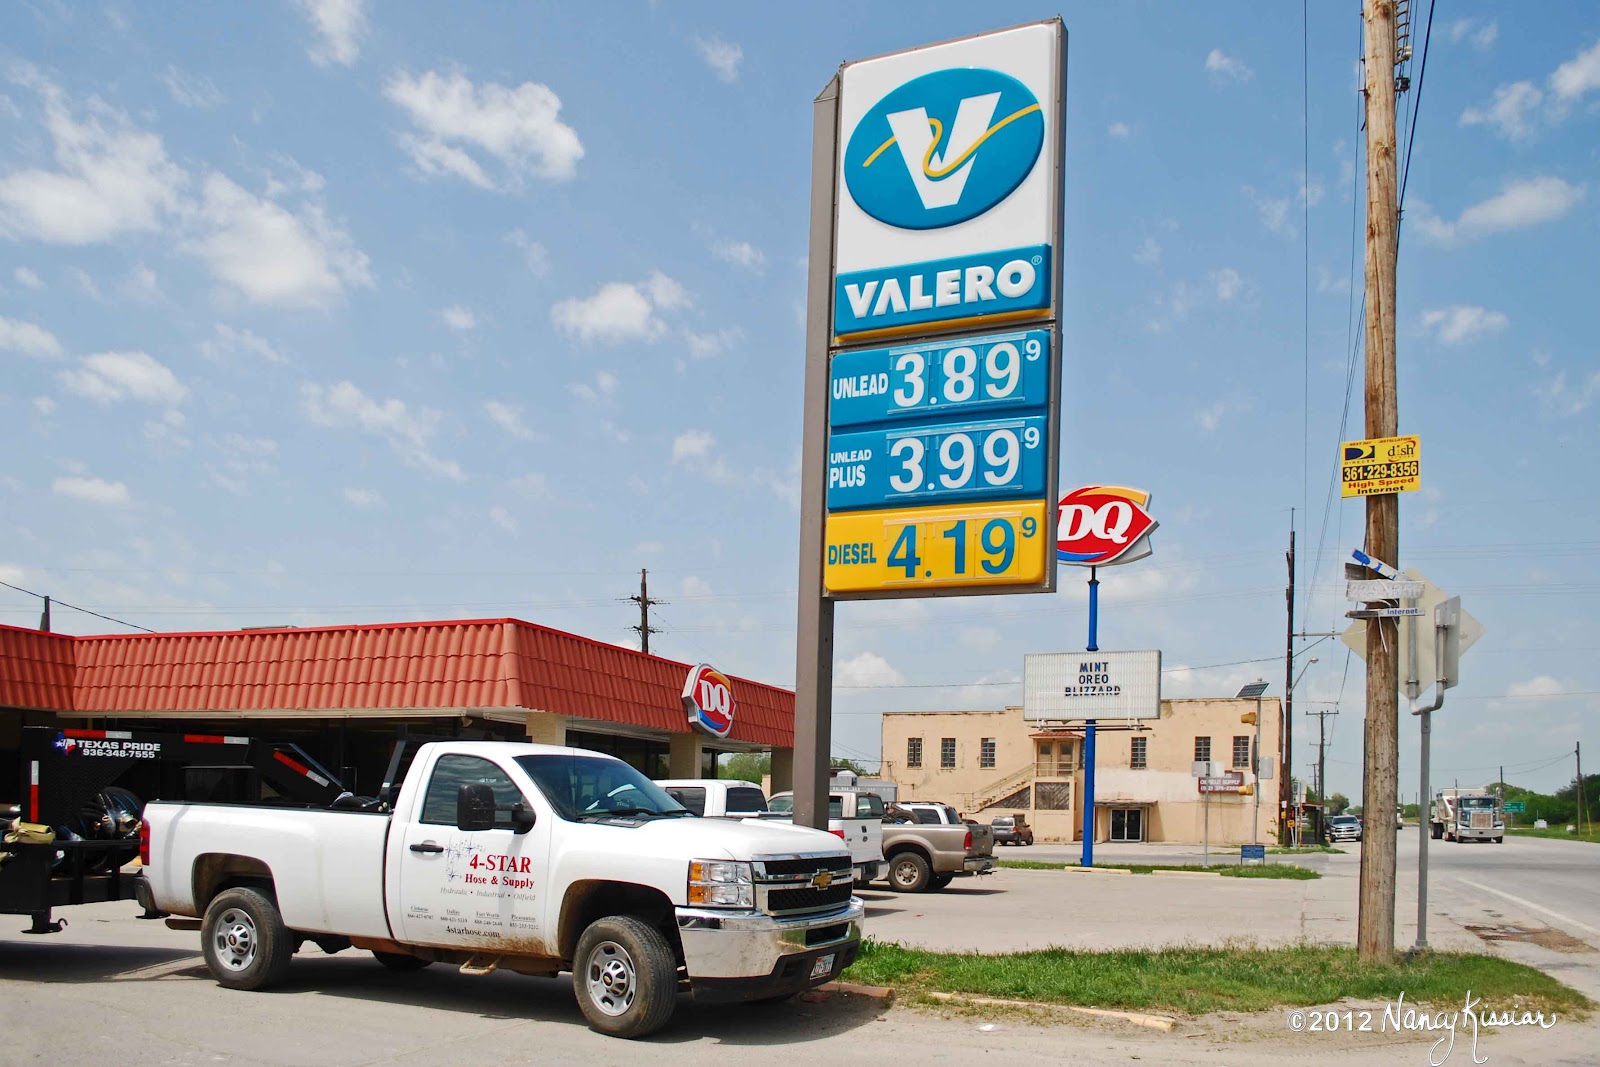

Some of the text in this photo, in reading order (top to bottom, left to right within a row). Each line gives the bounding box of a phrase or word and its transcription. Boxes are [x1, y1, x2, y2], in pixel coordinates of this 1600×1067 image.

[844, 259, 1036, 319] VALERO
[833, 372, 889, 400] UNLEAD
[830, 449, 872, 464] UNLEAD
[1387, 444, 1414, 457] dish
[829, 464, 866, 489] PLUS
[1344, 462, 1418, 481] 361-229-8356
[1378, 477, 1414, 486] Speed
[1357, 486, 1404, 494] Internet
[1057, 501, 1133, 544] DQ
[828, 543, 877, 565] DIESEL
[1079, 662, 1108, 672] MINT
[1079, 674, 1109, 684] OREO
[1064, 686, 1121, 696] BLIZZARD
[699, 679, 733, 720] DQ
[77, 740, 161, 751] TEXAS PRIDE
[83, 749, 155, 758] 936-348-7555
[469, 854, 531, 873] 4-STAR
[465, 873, 535, 889] Hose & Supply
[440, 886, 468, 896] Hydraulic
[476, 890, 505, 898] Industrial
[446, 925, 501, 937] 4starhose.com
